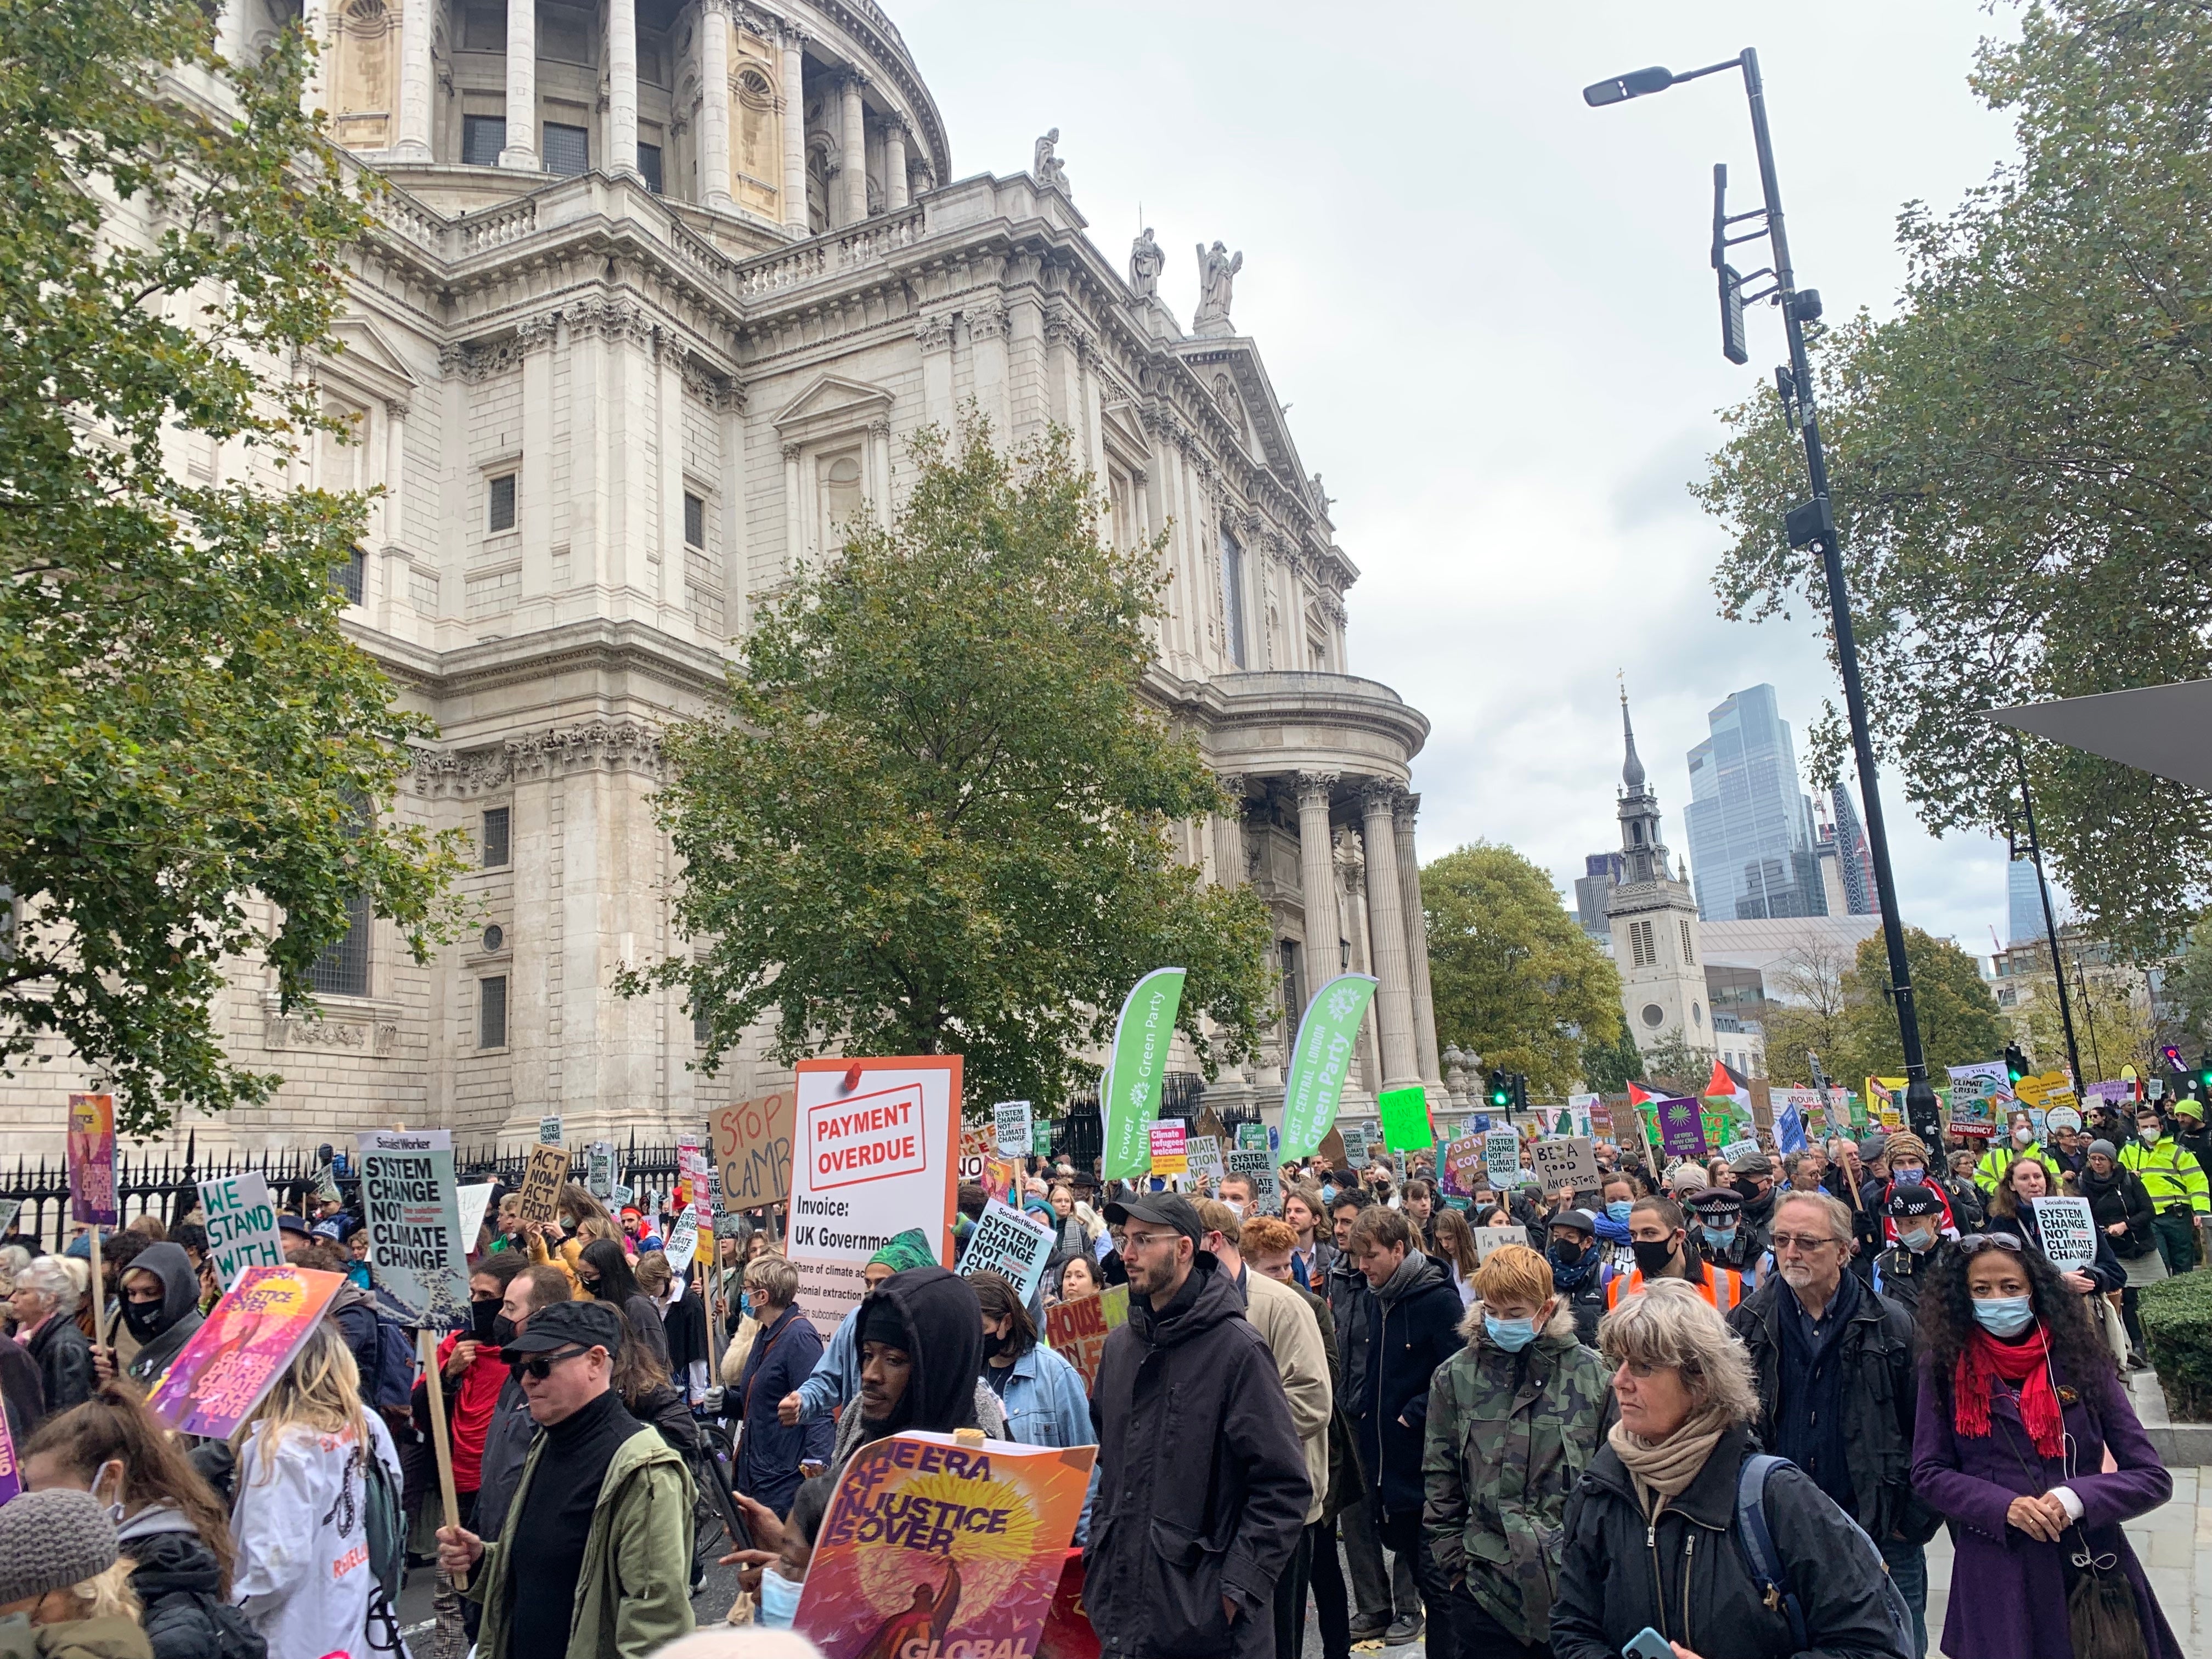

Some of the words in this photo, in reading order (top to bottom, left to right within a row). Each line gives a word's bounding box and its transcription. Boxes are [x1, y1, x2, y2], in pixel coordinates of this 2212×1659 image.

[1146, 991, 1165, 1029] Party
[1139, 1034, 1155, 1077] Green
[1289, 1115, 1302, 1144] WEST
[1296, 1069, 1314, 1113] CENTRAL
[1307, 1024, 1325, 1064] LONDON
[1990, 1070, 2006, 1084] WAR
[1304, 1089, 1332, 1148] Green
[1318, 1031, 1350, 1086] Party
[1383, 1097, 1401, 1108] SAVE
[1404, 1092, 1422, 1105] OUR
[817, 1102, 912, 1142] PAYMENT
[996, 1109, 1023, 1118] SYSTEM
[997, 1115, 1025, 1124] CHANGE
[1386, 1106, 1421, 1122] PLANET
[540, 1124, 560, 1133] SYSTEM
[720, 1094, 782, 1156] STOP
[998, 1128, 1026, 1137] CLIMATE
[1781, 1119, 1797, 1140] CLIMATE
[1951, 1124, 1991, 1135] EMERGENCY
[541, 1132, 560, 1141] CHANGE
[998, 1135, 1026, 1143] CHANGE
[1119, 1116, 1134, 1161] Tower
[1132, 1110, 1150, 1167] Hamlets
[1151, 1131, 1180, 1139] Climate
[1152, 1139, 1184, 1148] refugees
[1684, 1137, 1699, 1145] deal
[1785, 1129, 1800, 1149] JUSTICE
[532, 1150, 565, 1171] ACT
[818, 1136, 916, 1175] OVERDUE
[1152, 1147, 1184, 1155] welcome
[1187, 1153, 1218, 1167] CTION
[1231, 1154, 1267, 1163] SYSTEM
[1537, 1147, 1556, 1161] BE
[1567, 1143, 1578, 1157] A
[1726, 1146, 1752, 1158] SYSTEM
[366, 1157, 433, 1179] SYSTEM
[1232, 1162, 1270, 1171] CHANGE
[1544, 1161, 1576, 1177] GOOD
[529, 1169, 560, 1188] NOW
[1548, 1175, 1596, 1189] ANCESTOR
[203, 1181, 242, 1215] WE
[368, 1180, 441, 1203] CHANGE
[523, 1183, 554, 1203] ACT
[370, 1201, 403, 1223] NOT
[520, 1199, 552, 1223] FAIR
[797, 1195, 849, 1217] Invoice:
[2039, 1209, 2083, 1218] SYSTEM
[207, 1205, 273, 1248] STAND
[677, 1221, 697, 1231] CHANGE
[998, 1207, 1024, 1224] Socialist
[1023, 1220, 1043, 1235] Worker
[2042, 1219, 2087, 1229] CHANGE
[374, 1224, 448, 1248] CLIMATE
[670, 1235, 692, 1247] CLIMATE
[796, 1226, 815, 1246] UK
[983, 1215, 1038, 1251] SYSTEM
[2045, 1229, 2069, 1239] NOT
[666, 1243, 689, 1254] CHANGE
[972, 1239, 1003, 1262] NOT
[978, 1228, 1036, 1266] CHANGE
[2047, 1240, 2093, 1250] CLIMATE
[216, 1240, 279, 1277] WITH
[377, 1246, 449, 1270] CHANGE
[2050, 1250, 2093, 1260] CHANGE
[816, 1264, 824, 1274] of
[826, 1265, 853, 1278] climate
[797, 1284, 821, 1296] olonial
[823, 1288, 862, 1301] extraction
[1046, 1295, 1108, 1347] HOUSE
[220, 1351, 276, 1365] GLOBAL
[211, 1362, 242, 1376] DAY
[242, 1367, 274, 1381] FOR
[198, 1373, 261, 1393] CLIMATE
[190, 1386, 250, 1405] JUSTICE
[230, 1406, 243, 1419] 6
[918, 1446, 990, 1482] ERA
[843, 1466, 890, 1496] OF
[832, 1493, 1012, 1534] INJUSTICE
[821, 1520, 856, 1548] IS
[857, 1516, 955, 1555] OVER
[900, 1638, 1032, 1659] GLOBAL
